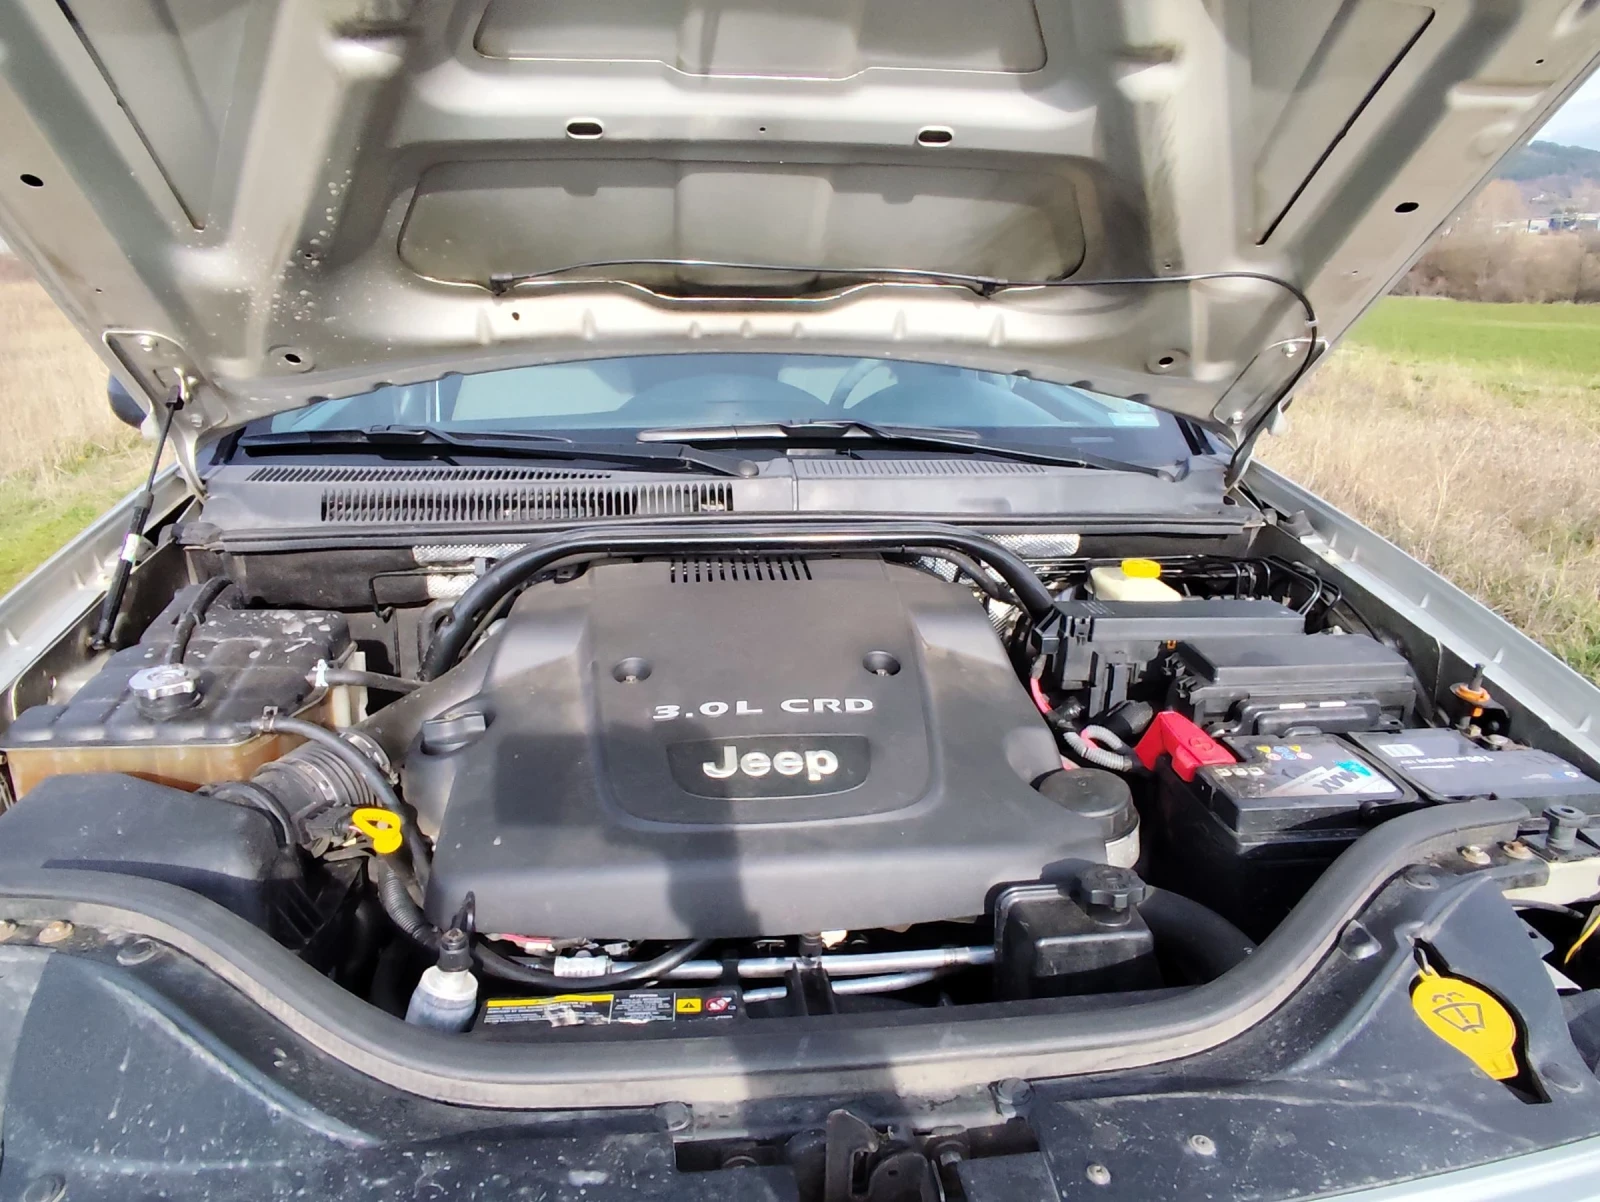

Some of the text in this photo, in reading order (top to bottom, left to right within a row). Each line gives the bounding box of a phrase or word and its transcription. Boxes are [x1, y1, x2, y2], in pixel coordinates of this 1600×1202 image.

[652, 698, 874, 720] 3.0L CRD
[702, 745, 839, 781] Jeep
